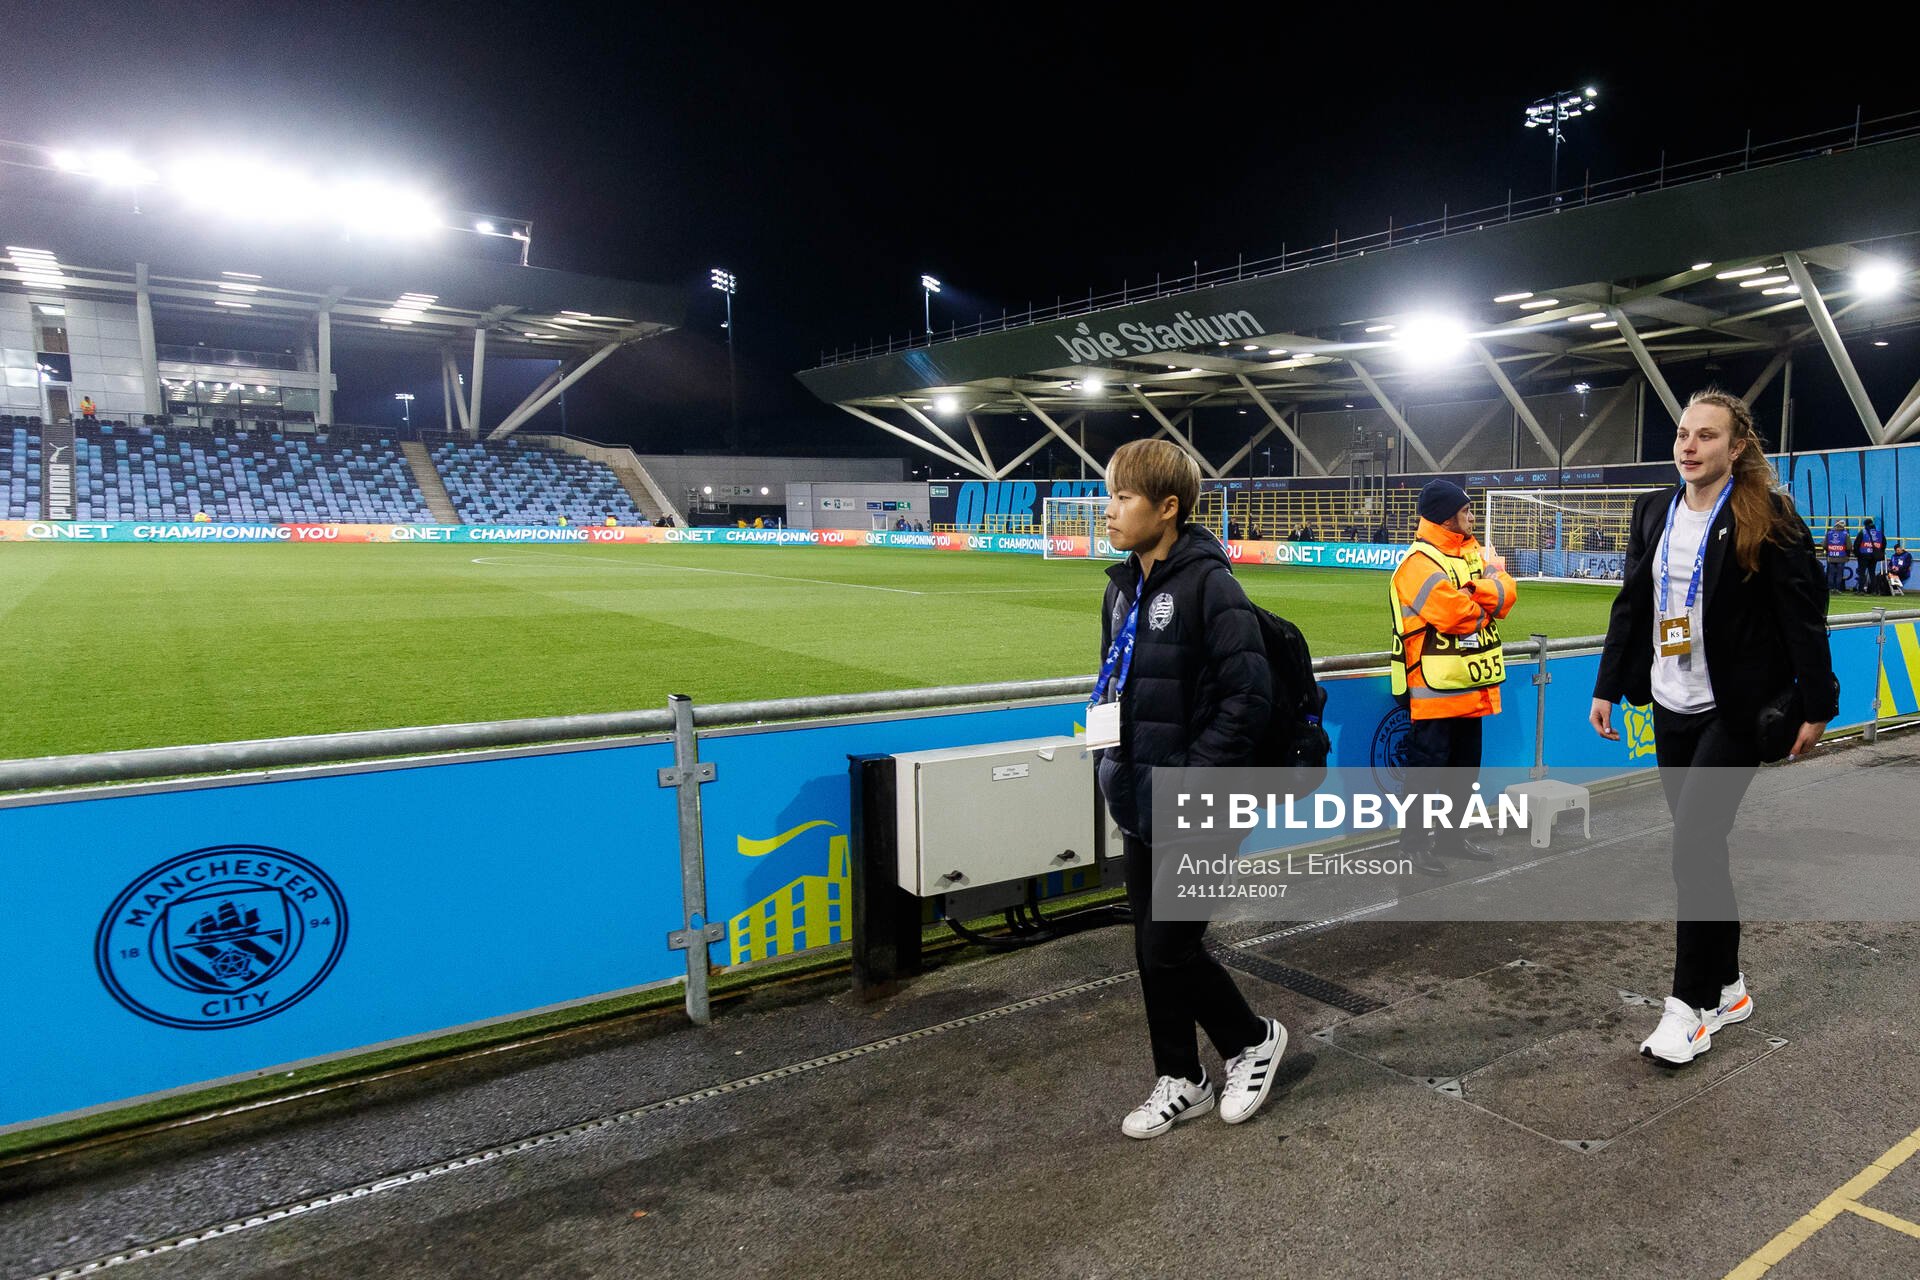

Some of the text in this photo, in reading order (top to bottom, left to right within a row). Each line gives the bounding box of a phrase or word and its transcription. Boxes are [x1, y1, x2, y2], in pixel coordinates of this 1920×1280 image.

[1055, 310, 1266, 363] Joie Stadium
[49, 464, 72, 519] PUMA
[955, 481, 1037, 532] OUR
[27, 523, 339, 539] QNET CHAMPIONING YOU
[391, 527, 625, 540] QNET CHAMPIONING YOU
[665, 529, 844, 542] QNET CHAMPIONING YOU
[866, 532, 951, 547] QNET CHAMPIONING YOU
[968, 535, 993, 548] QNET
[1056, 540, 1074, 552] YOU
[1276, 545, 1405, 566] QNET CHAMPIO
[1467, 654, 1502, 682] 035
[124, 859, 318, 927] MANCHESTER
[120, 916, 331, 959] 18 94
[201, 990, 270, 1017] CITY
